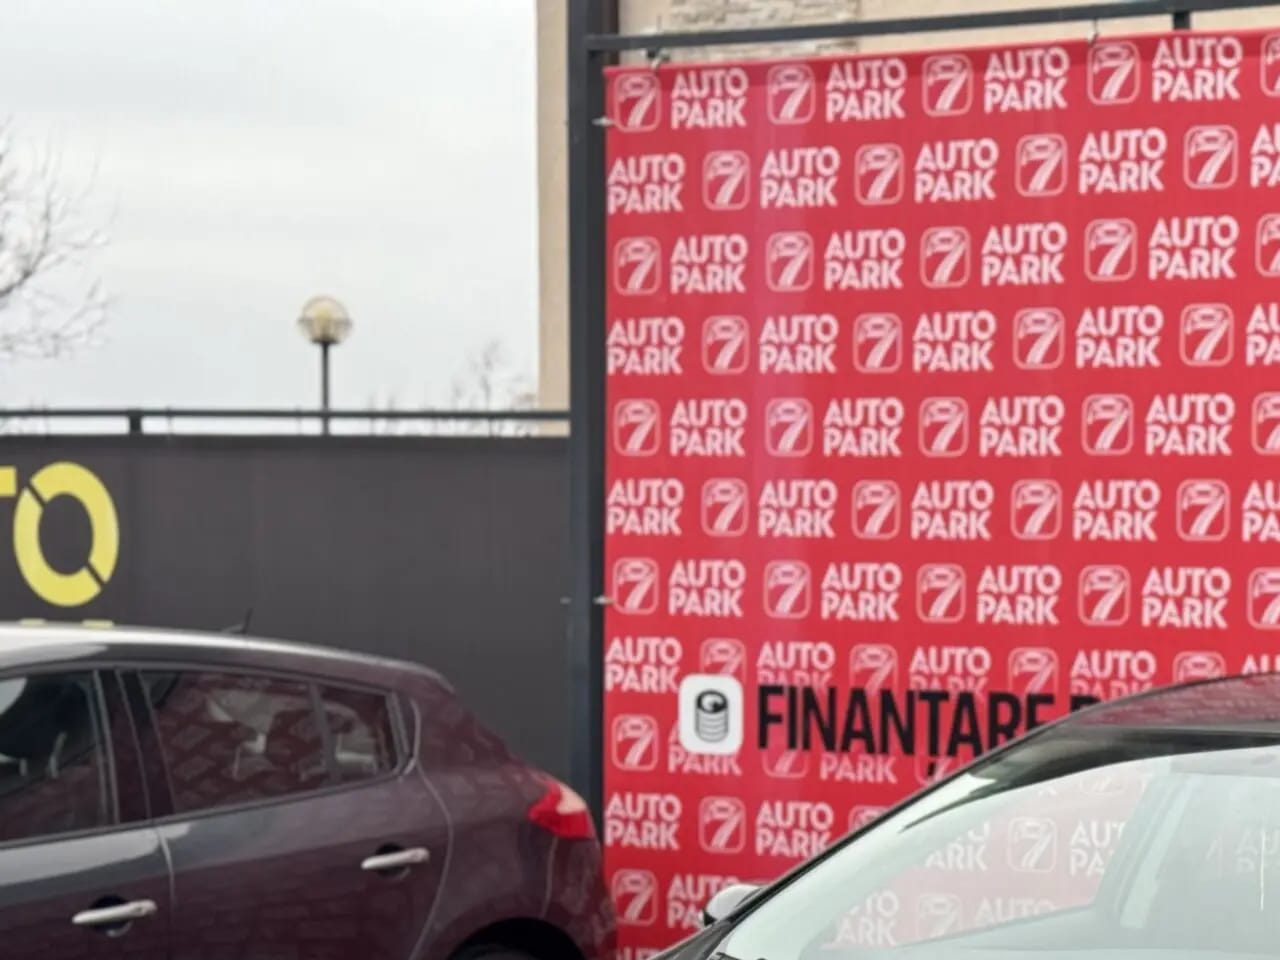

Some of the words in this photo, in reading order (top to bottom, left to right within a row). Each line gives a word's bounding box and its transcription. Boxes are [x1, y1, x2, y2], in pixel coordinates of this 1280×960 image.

[984, 48, 1069, 80] AUTO
[1153, 38, 1242, 70] AUTO
[672, 68, 749, 98] AUTO
[826, 59, 907, 91] AUTO
[1152, 68, 1240, 101] PARK
[826, 90, 906, 121] PARK
[984, 78, 1068, 112] PARK
[671, 97, 746, 128] PARK
[915, 138, 999, 170] AUTO
[1079, 128, 1167, 161] AUTO
[608, 154, 685, 184] AUTO
[761, 146, 840, 178] AUTO
[1078, 159, 1164, 193] PARK
[608, 181, 683, 214] PARK
[760, 176, 838, 208] PARK
[914, 168, 997, 201] PARK
[825, 229, 905, 260] AUTO
[982, 221, 1067, 254] AUTO
[1150, 216, 1239, 249] AUTO
[671, 234, 748, 265] AUTO
[1149, 246, 1236, 280] PARK
[670, 261, 745, 293] PARK
[824, 258, 902, 289] PARK
[981, 251, 1065, 285] PARK
[608, 316, 684, 348] AUTO
[761, 314, 839, 344] AUTO
[914, 311, 996, 341] AUTO
[1077, 306, 1164, 338] AUTO
[606, 346, 682, 375] PARK
[759, 342, 837, 374] PARK
[913, 341, 995, 373] PARK
[1076, 337, 1161, 368] PARK
[671, 400, 748, 430] AUTO
[824, 398, 904, 427] AUTO
[981, 396, 1065, 426] AUTO
[1147, 394, 1235, 425] AUTO
[670, 428, 746, 456] PARK
[824, 425, 902, 457] PARK
[979, 425, 1063, 457] PARK
[1146, 424, 1232, 457] PARK
[608, 479, 684, 508] AUTO
[760, 479, 838, 508] AUTO
[912, 480, 994, 510] AUTO
[1074, 480, 1161, 511] AUTO
[606, 507, 681, 536] PARK
[758, 508, 835, 538] PARK
[911, 509, 991, 541] PARK
[1072, 510, 1158, 542] PARK
[669, 561, 746, 591] AUTO
[822, 563, 902, 593] AUTO
[978, 565, 1062, 596] AUTO
[1143, 568, 1231, 598] AUTO
[668, 588, 743, 618] PARK
[821, 592, 899, 622] PARK
[976, 594, 1059, 625] PARK
[1141, 596, 1228, 629] PARK
[605, 637, 683, 663] AUTO
[757, 642, 835, 669] AUTO
[910, 649, 990, 677] AUTO
[1070, 651, 1156, 680] AUTO
[604, 665, 680, 693] PARK
[821, 754, 896, 783] PARK
[605, 794, 681, 820] AUTO
[756, 802, 834, 828] AUTO
[604, 821, 680, 850] PARK
